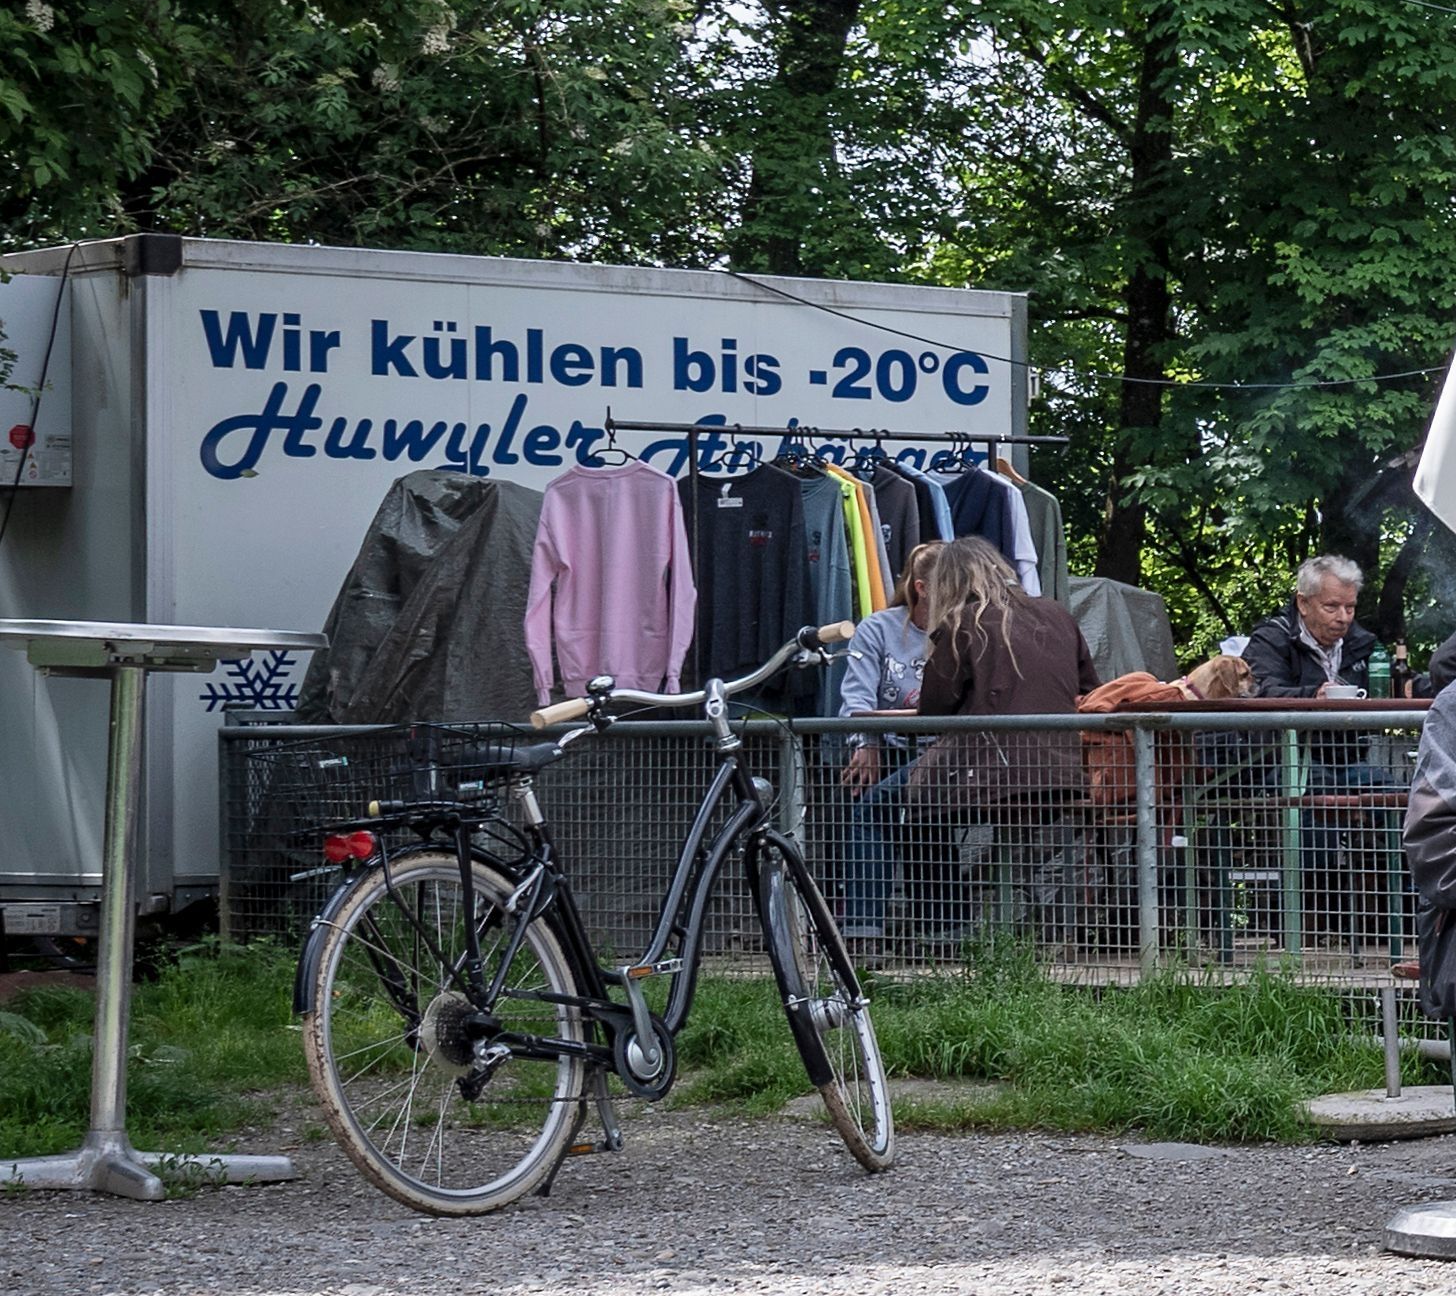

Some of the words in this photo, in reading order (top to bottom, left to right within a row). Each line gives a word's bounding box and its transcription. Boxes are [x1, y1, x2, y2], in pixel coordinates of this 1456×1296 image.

[199, 309, 341, 373] Wir
[371, 319, 643, 388] kühlen
[673, 336, 782, 396] bis
[809, 346, 991, 406] -20°C
[200, 381, 606, 480] Huwyler
